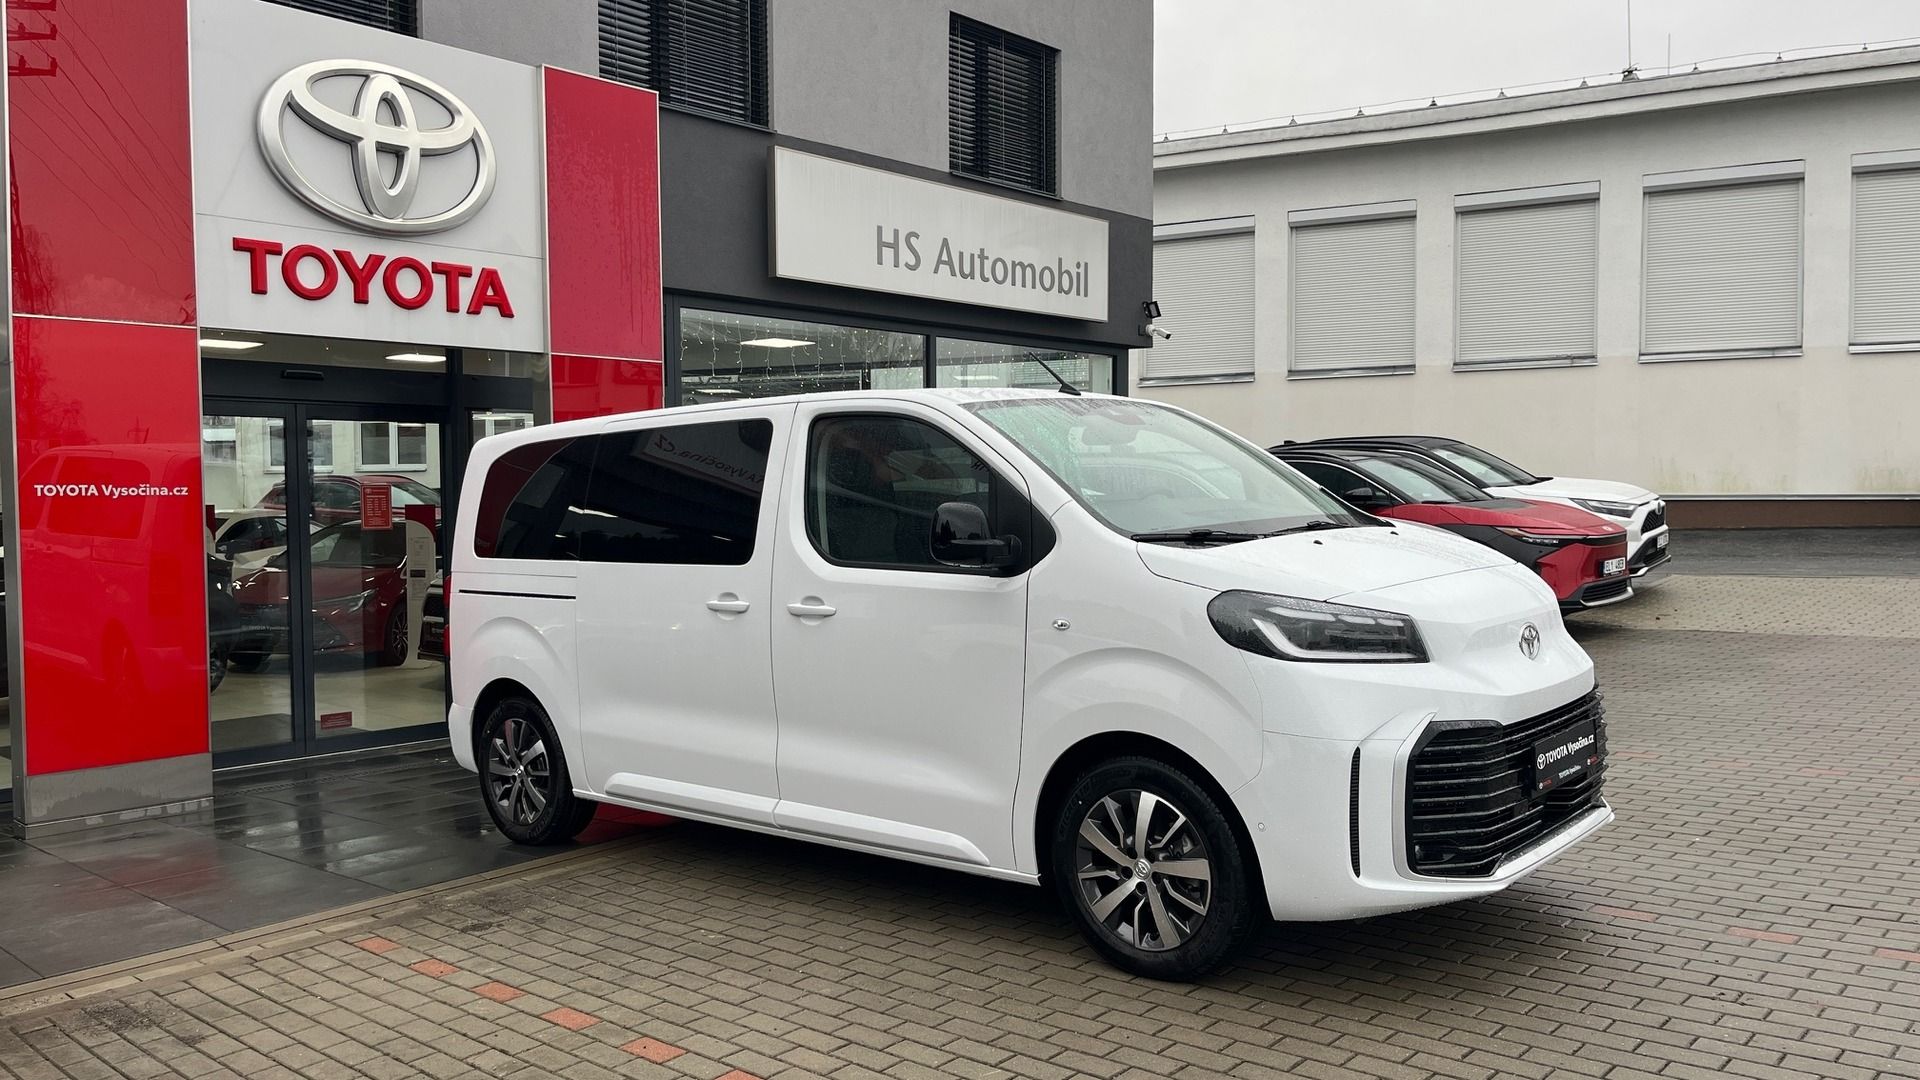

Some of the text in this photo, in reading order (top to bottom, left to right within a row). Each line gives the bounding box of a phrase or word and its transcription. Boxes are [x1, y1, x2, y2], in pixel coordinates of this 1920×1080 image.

[233, 236, 515, 318] TOYOTA
[875, 224, 1090, 298] HS Automobil
[34, 483, 189, 499] TOYOTA Vysočina.cz
[1545, 744, 1568, 764] TOYOTA
